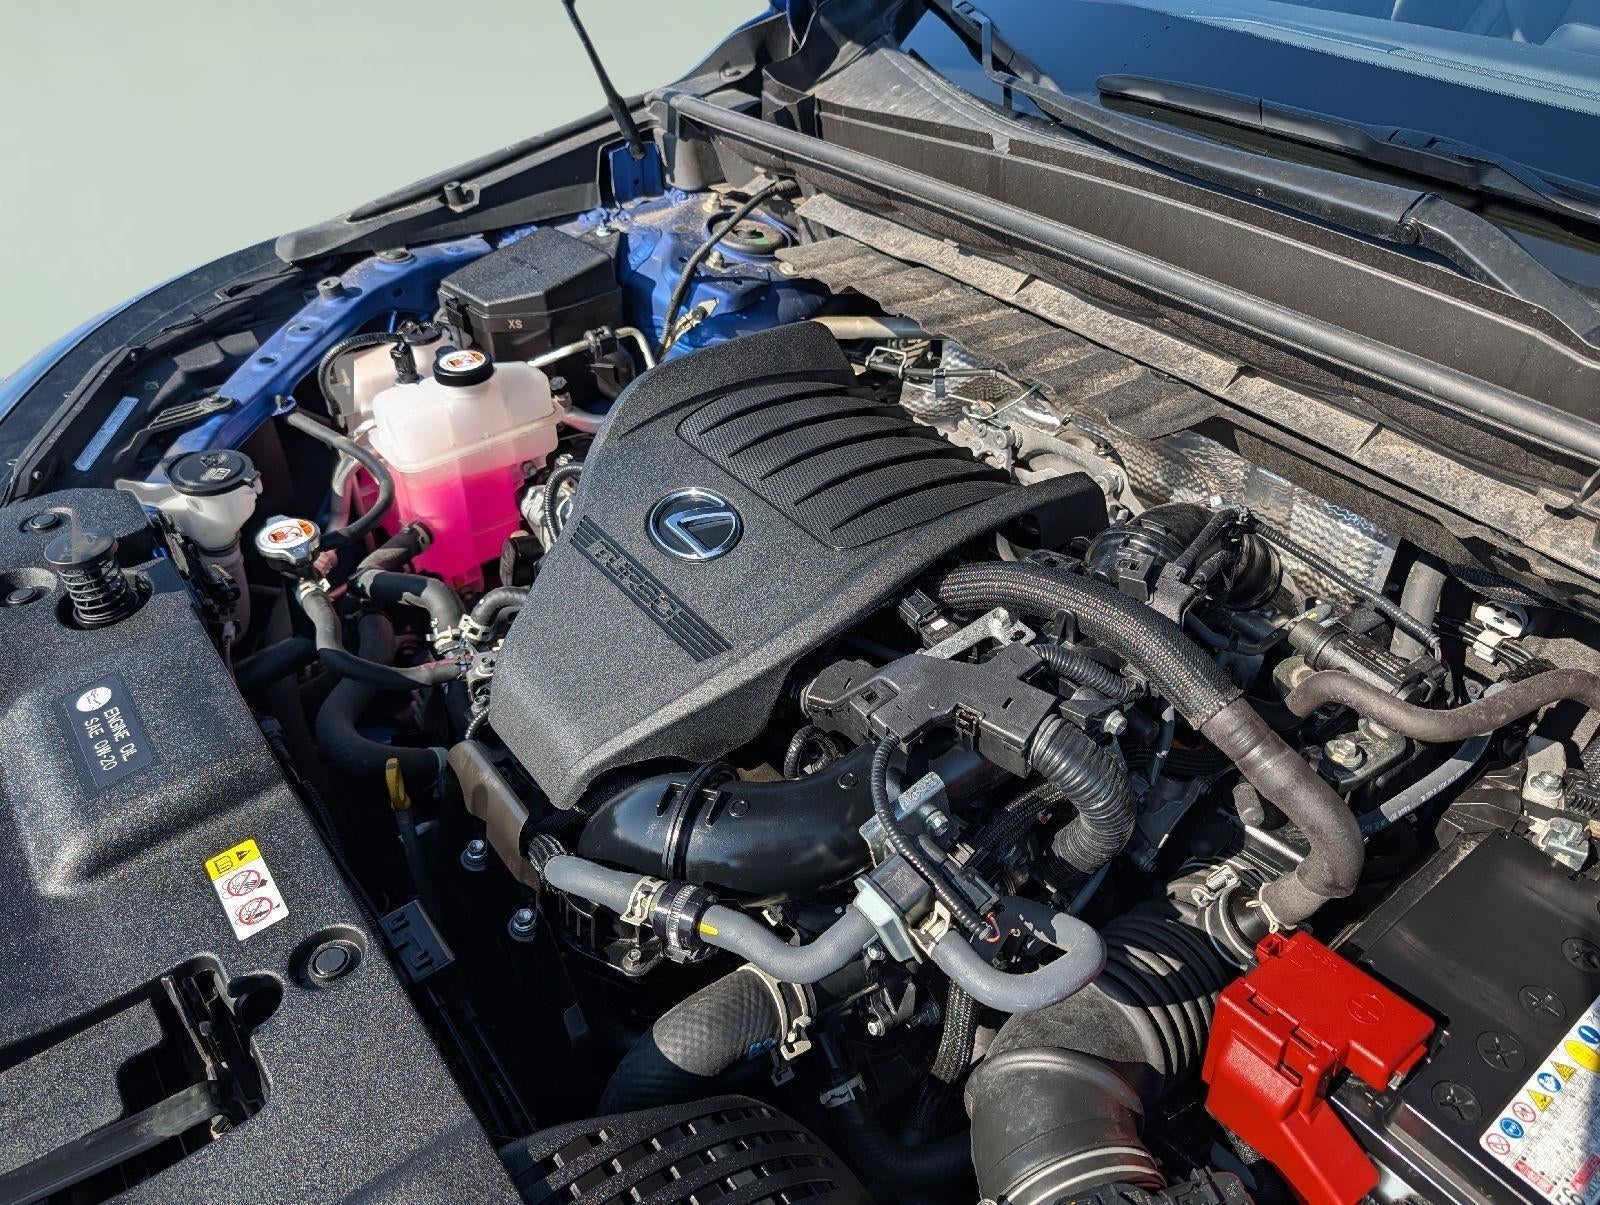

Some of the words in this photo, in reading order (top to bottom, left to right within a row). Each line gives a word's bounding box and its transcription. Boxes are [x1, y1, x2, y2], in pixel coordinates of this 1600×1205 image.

[507, 319, 522, 330] XS
[593, 540, 678, 620] TURBO
[84, 717, 104, 739] SAE
[103, 706, 131, 742] ENGINE
[120, 742, 138, 762] OIL
